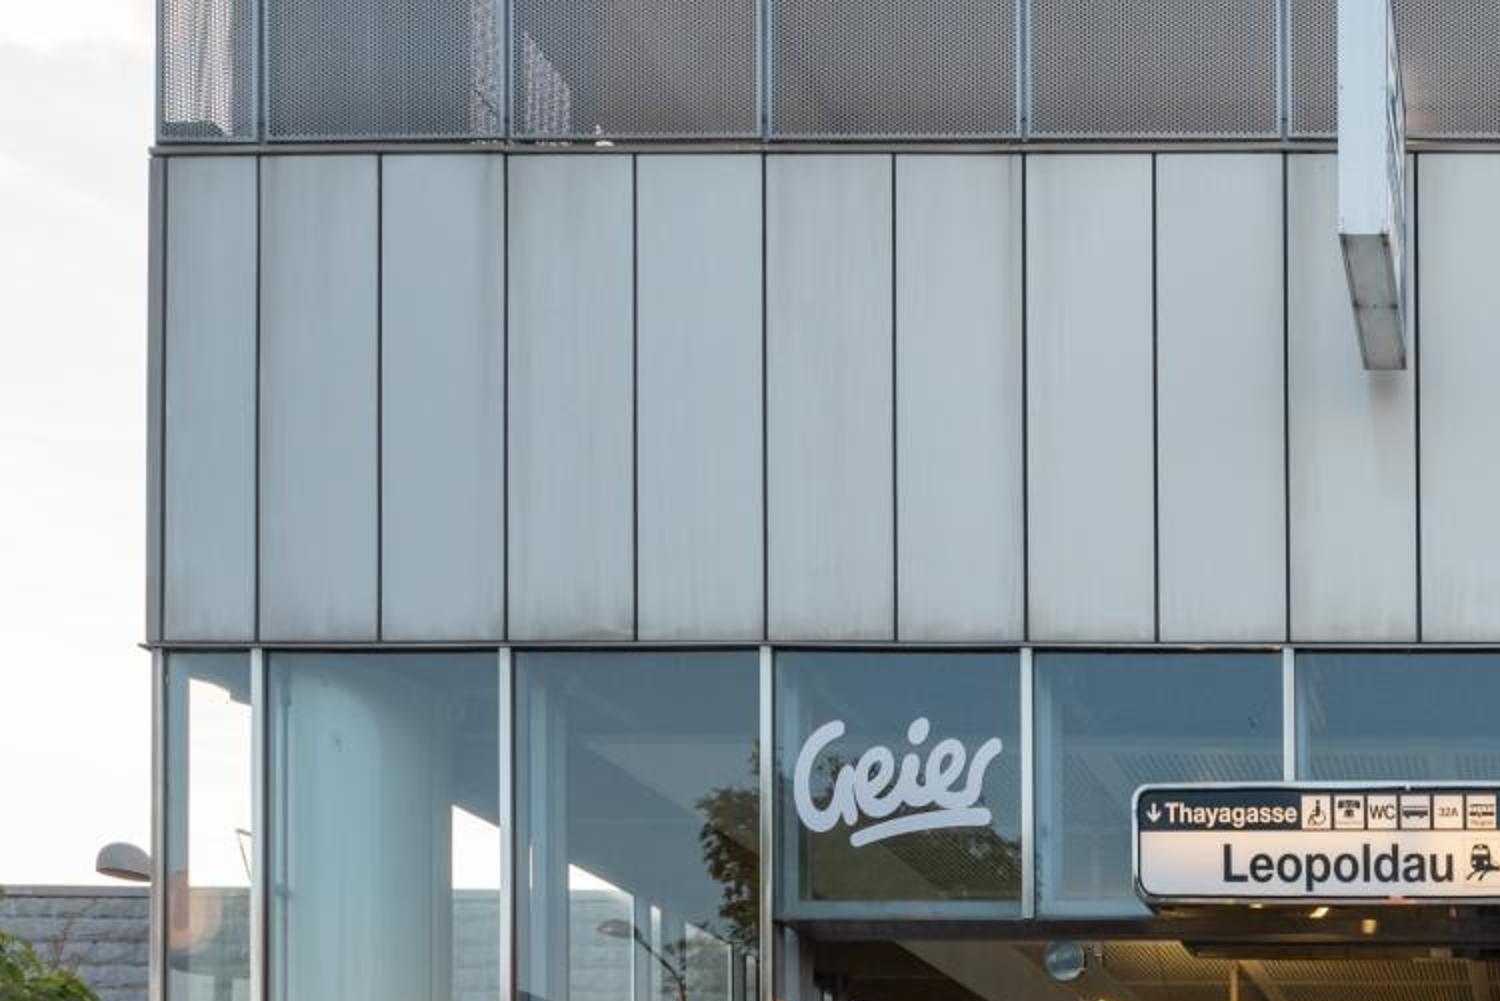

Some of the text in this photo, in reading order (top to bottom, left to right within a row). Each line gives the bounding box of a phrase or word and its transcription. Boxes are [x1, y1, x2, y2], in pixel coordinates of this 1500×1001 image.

[793, 717, 1003, 833] Geier
[1164, 799, 1298, 827] Thayagasse
[1369, 803, 1396, 820] WC
[1223, 843, 1453, 892] Leopoldau
